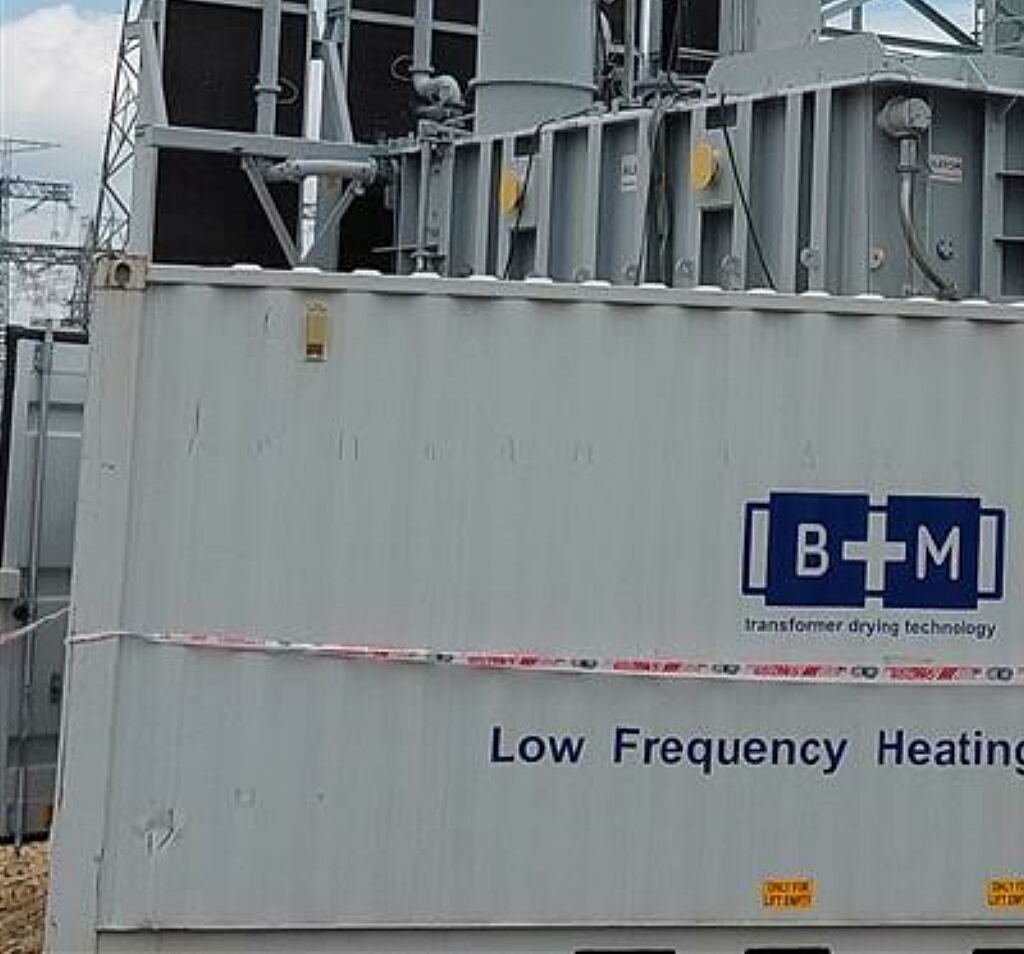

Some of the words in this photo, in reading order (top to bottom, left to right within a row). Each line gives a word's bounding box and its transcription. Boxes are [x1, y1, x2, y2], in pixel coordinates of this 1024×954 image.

[745, 617, 843, 633] transformer
[849, 618, 899, 638] drying
[904, 619, 997, 639] technology
[490, 726, 586, 764] Low
[613, 727, 848, 775] Frequency
